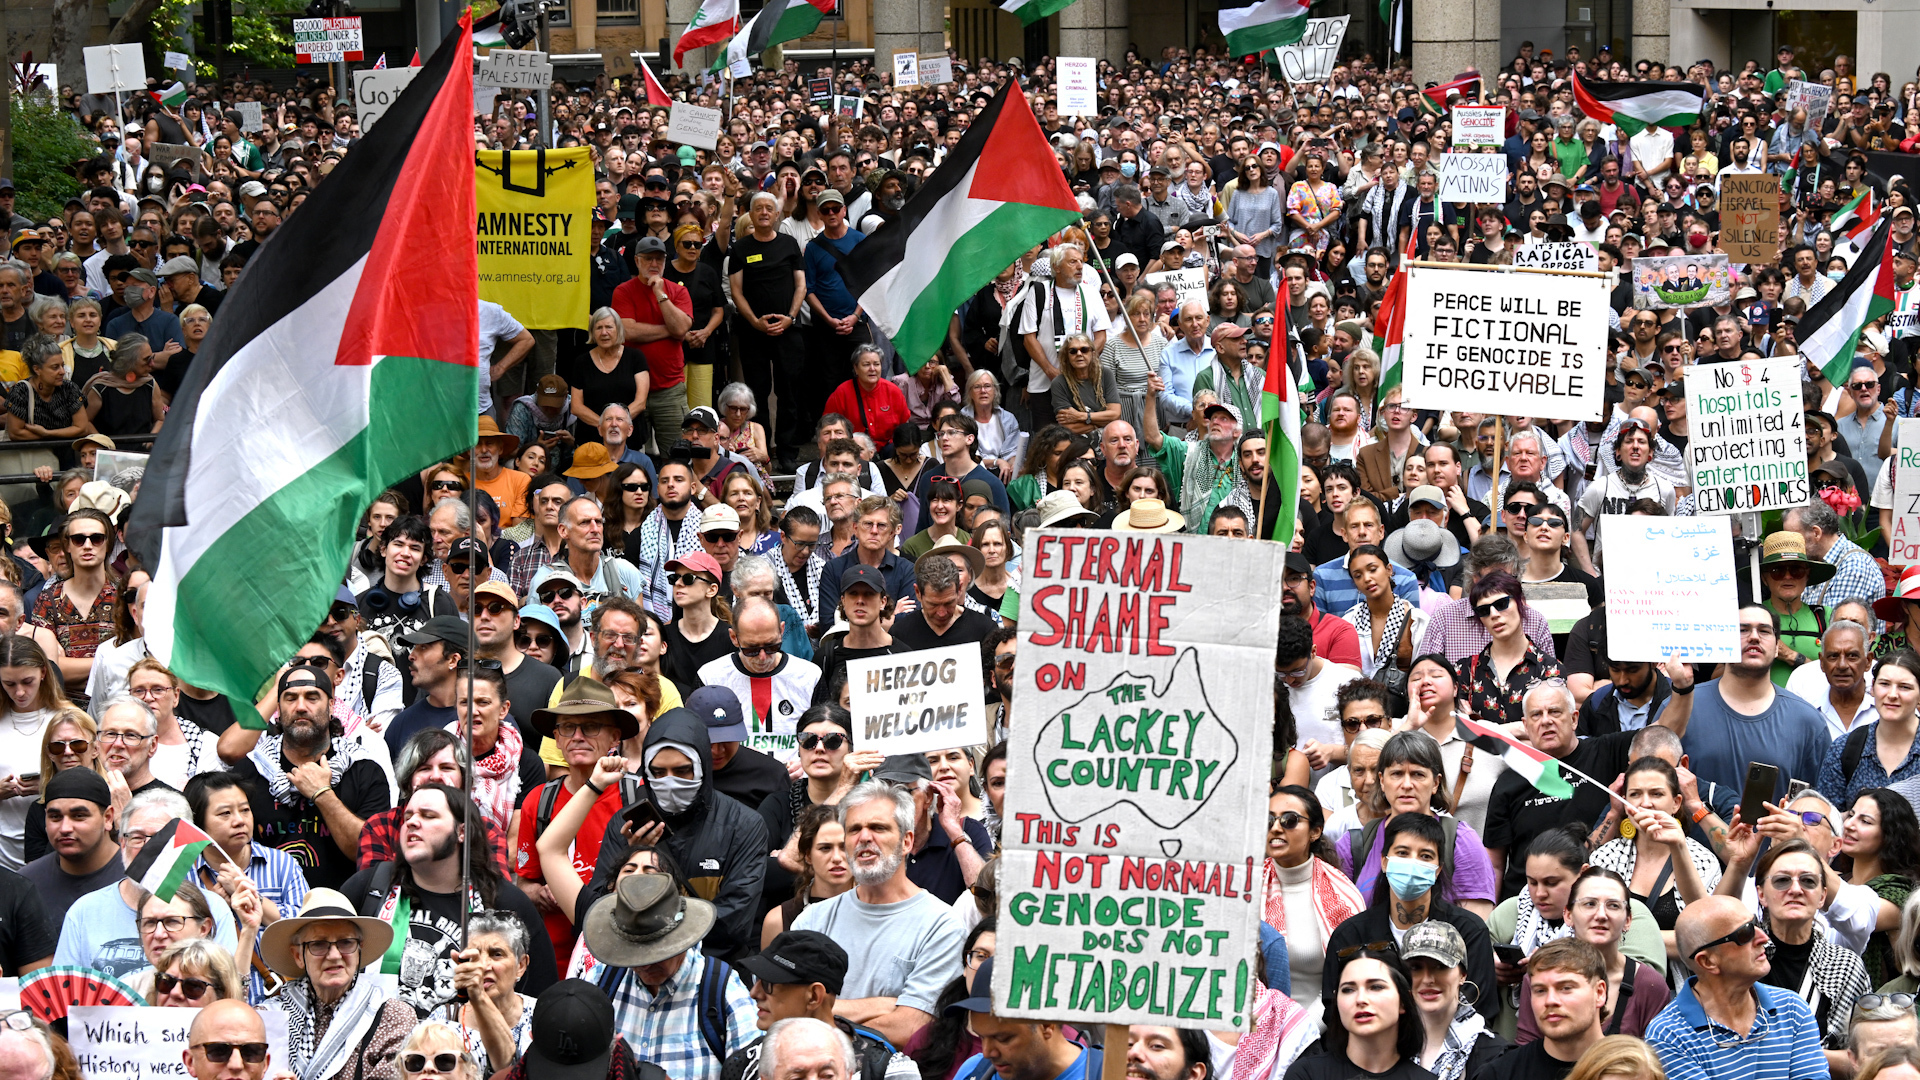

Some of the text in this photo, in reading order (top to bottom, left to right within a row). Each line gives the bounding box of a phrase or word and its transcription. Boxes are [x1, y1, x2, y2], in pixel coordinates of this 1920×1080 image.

[296, 29, 359, 42] CHILDREN UNDER 5
[323, 18, 360, 30] PALESTINIAN
[297, 41, 360, 52] MURDERED UNDER
[311, 51, 342, 62] HERZOG
[494, 53, 538, 68] FREE
[1283, 46, 1337, 81] OUT
[480, 69, 549, 85] PALESTINE
[1460, 118, 1495, 127] GENOCIDE
[1442, 155, 1506, 175] MOSSAD
[1441, 175, 1500, 197] MINNS
[1722, 180, 1778, 194] SANCTION
[1726, 196, 1771, 211] ISRAEL
[476, 212, 573, 236] AMNESTY
[1736, 213, 1759, 226] NOT
[476, 241, 573, 255] INTERNATIONAL
[1725, 228, 1777, 244] SILENCE
[1516, 247, 1594, 263] RADICAL
[1741, 245, 1761, 257] US
[1165, 273, 1185, 282] WAR
[1433, 292, 1582, 318] PEACE WILL BE
[1433, 316, 1578, 346] FICTIONAL
[1426, 343, 1584, 370] IF GENOCIDE IS
[1422, 365, 1584, 398] FORGIVABLE
[1741, 365, 1752, 386] $
[1760, 368, 1770, 383] 4
[1698, 387, 1781, 415] hospitals
[1701, 410, 1801, 438] unlimited 4
[1694, 438, 1785, 466] protecting
[1696, 460, 1805, 487] entertaining
[1698, 479, 1807, 512] GENOCIDAIRES
[1645, 527, 1665, 540] مع
[1034, 535, 1193, 593] ETERNAL
[1692, 545, 1720, 561] غزة
[1028, 584, 1177, 657] SHAME
[1652, 623, 1737, 632] הומואים עם עזה
[1718, 646, 1734, 657] די
[866, 657, 957, 693] HERZOG
[1035, 661, 1086, 692] ON
[898, 690, 928, 706] NOT
[1106, 683, 1147, 705] THE
[864, 702, 969, 740] WELCOME
[1061, 708, 1205, 759] LACKEY
[1046, 757, 1220, 801] COUNTRY
[1015, 812, 1121, 848] THIS IS
[1032, 850, 1254, 903] NOT NORMAL!
[1009, 891, 1205, 928] GENOCIDE
[1082, 928, 1229, 956] DOES NOT
[1006, 944, 1249, 1027] METABOLIZE!
[84, 1020, 150, 1045] Which
[79, 1053, 189, 1080] History were
